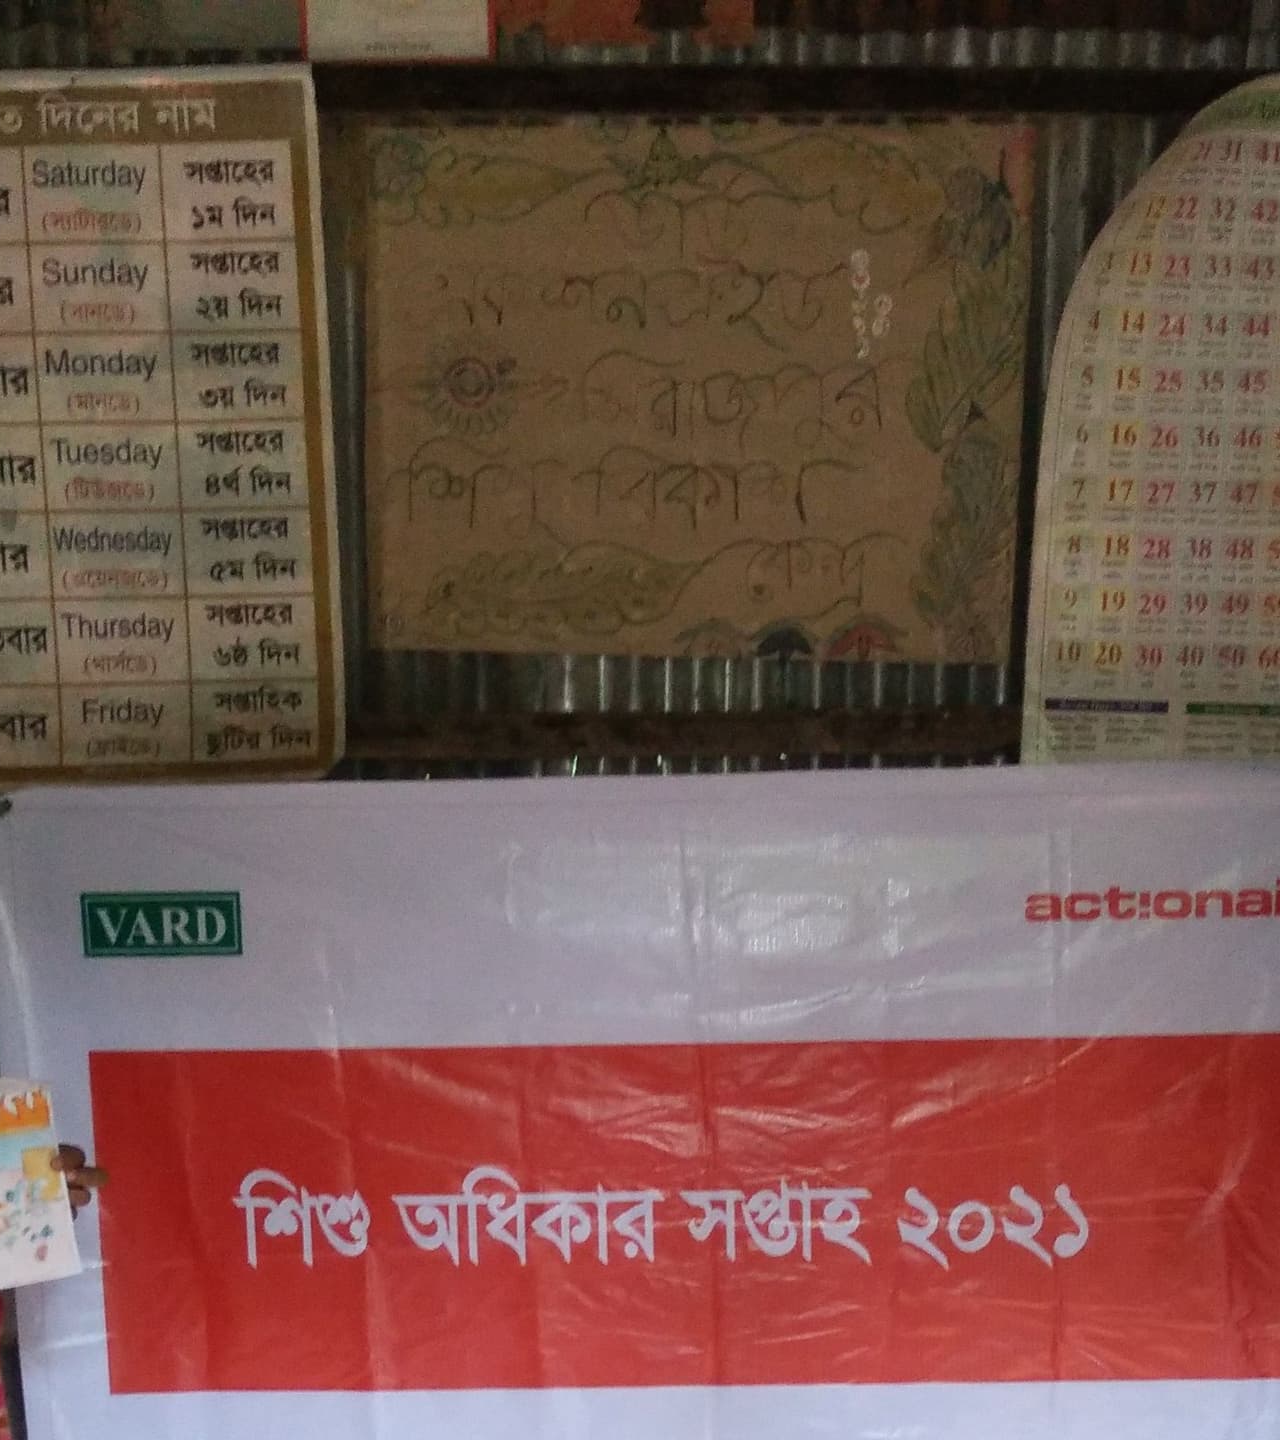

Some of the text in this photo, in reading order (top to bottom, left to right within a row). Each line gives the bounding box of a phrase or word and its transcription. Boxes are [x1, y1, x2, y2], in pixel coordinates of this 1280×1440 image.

[36, 92, 140, 134] দিনের
[153, 98, 215, 135] নাম
[32, 159, 146, 195] Saturday
[192, 196, 275, 229] ১ম দিন
[1174, 196, 1197, 219] 22
[1251, 199, 1277, 222] 42
[41, 257, 148, 292] Sunday
[1130, 252, 1151, 275] 13
[1165, 255, 1190, 277] 23
[1247, 256, 1274, 278] 43
[240, 287, 281, 318] দিন
[1089, 311, 1100, 331] 4
[1123, 312, 1144, 333] 14
[1159, 314, 1185, 336] 24
[44, 349, 157, 382] Monday
[244, 377, 287, 407] দিন
[1117, 368, 1140, 390] 15
[1155, 370, 1182, 392] 25
[1238, 370, 1267, 393] 45
[1077, 425, 1088, 443] 6
[1113, 424, 1136, 446] 16
[1151, 426, 1178, 448] 26
[1234, 427, 1262, 447] 46
[50, 437, 163, 470] Tuesday
[250, 466, 291, 495] দিন
[1072, 479, 1085, 499] 7
[1109, 479, 1133, 501] 17
[1147, 481, 1175, 503] 27
[53, 526, 171, 556] Wednesday
[1105, 535, 1129, 557] 18
[1144, 538, 1170, 560] 28
[1226, 538, 1253, 559] 48
[253, 552, 295, 581] দিন
[1065, 590, 1077, 607] 9
[1102, 592, 1125, 612] 19
[1139, 594, 1166, 615] 29
[1223, 594, 1249, 614] 49
[61, 612, 175, 644] Thursday
[258, 637, 300, 665] দিন
[1057, 642, 1081, 662] 10
[1095, 644, 1122, 665] 20
[1136, 647, 1162, 668] 30
[1178, 646, 1204, 667] 40
[82, 697, 165, 728] Friday
[270, 724, 312, 752] দিন
[97, 905, 226, 945] VARD
[235, 1164, 1090, 1271] শিশু অধিকার সপ্তাহ ২০২১
